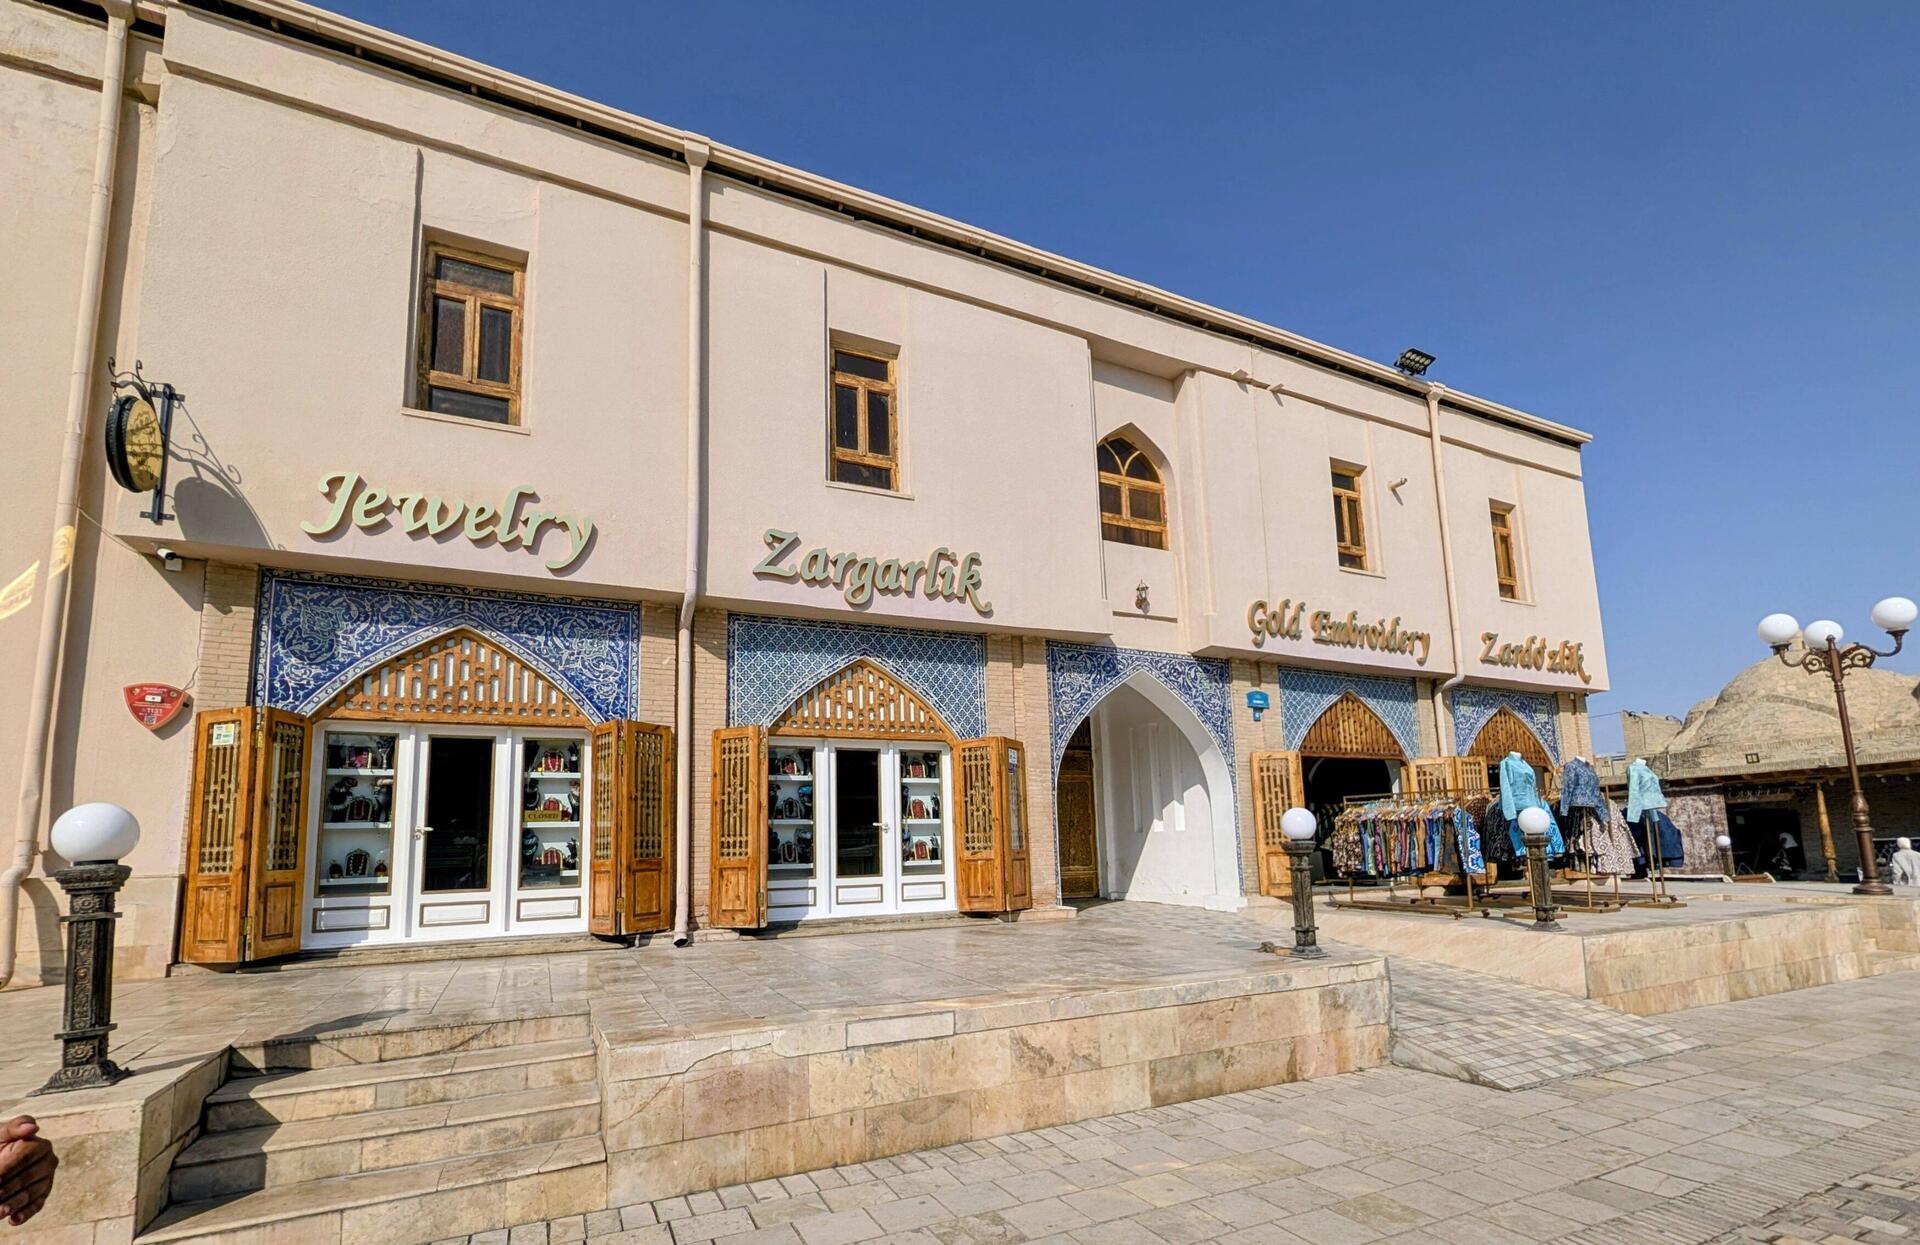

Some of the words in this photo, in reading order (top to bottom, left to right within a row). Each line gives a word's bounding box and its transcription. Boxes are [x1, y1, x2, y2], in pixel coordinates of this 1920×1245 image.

[300, 471, 593, 570] Jewelry
[753, 528, 992, 612] Zargarlik
[1249, 599, 1305, 648] Gold
[1310, 610, 1431, 666] Embroidery
